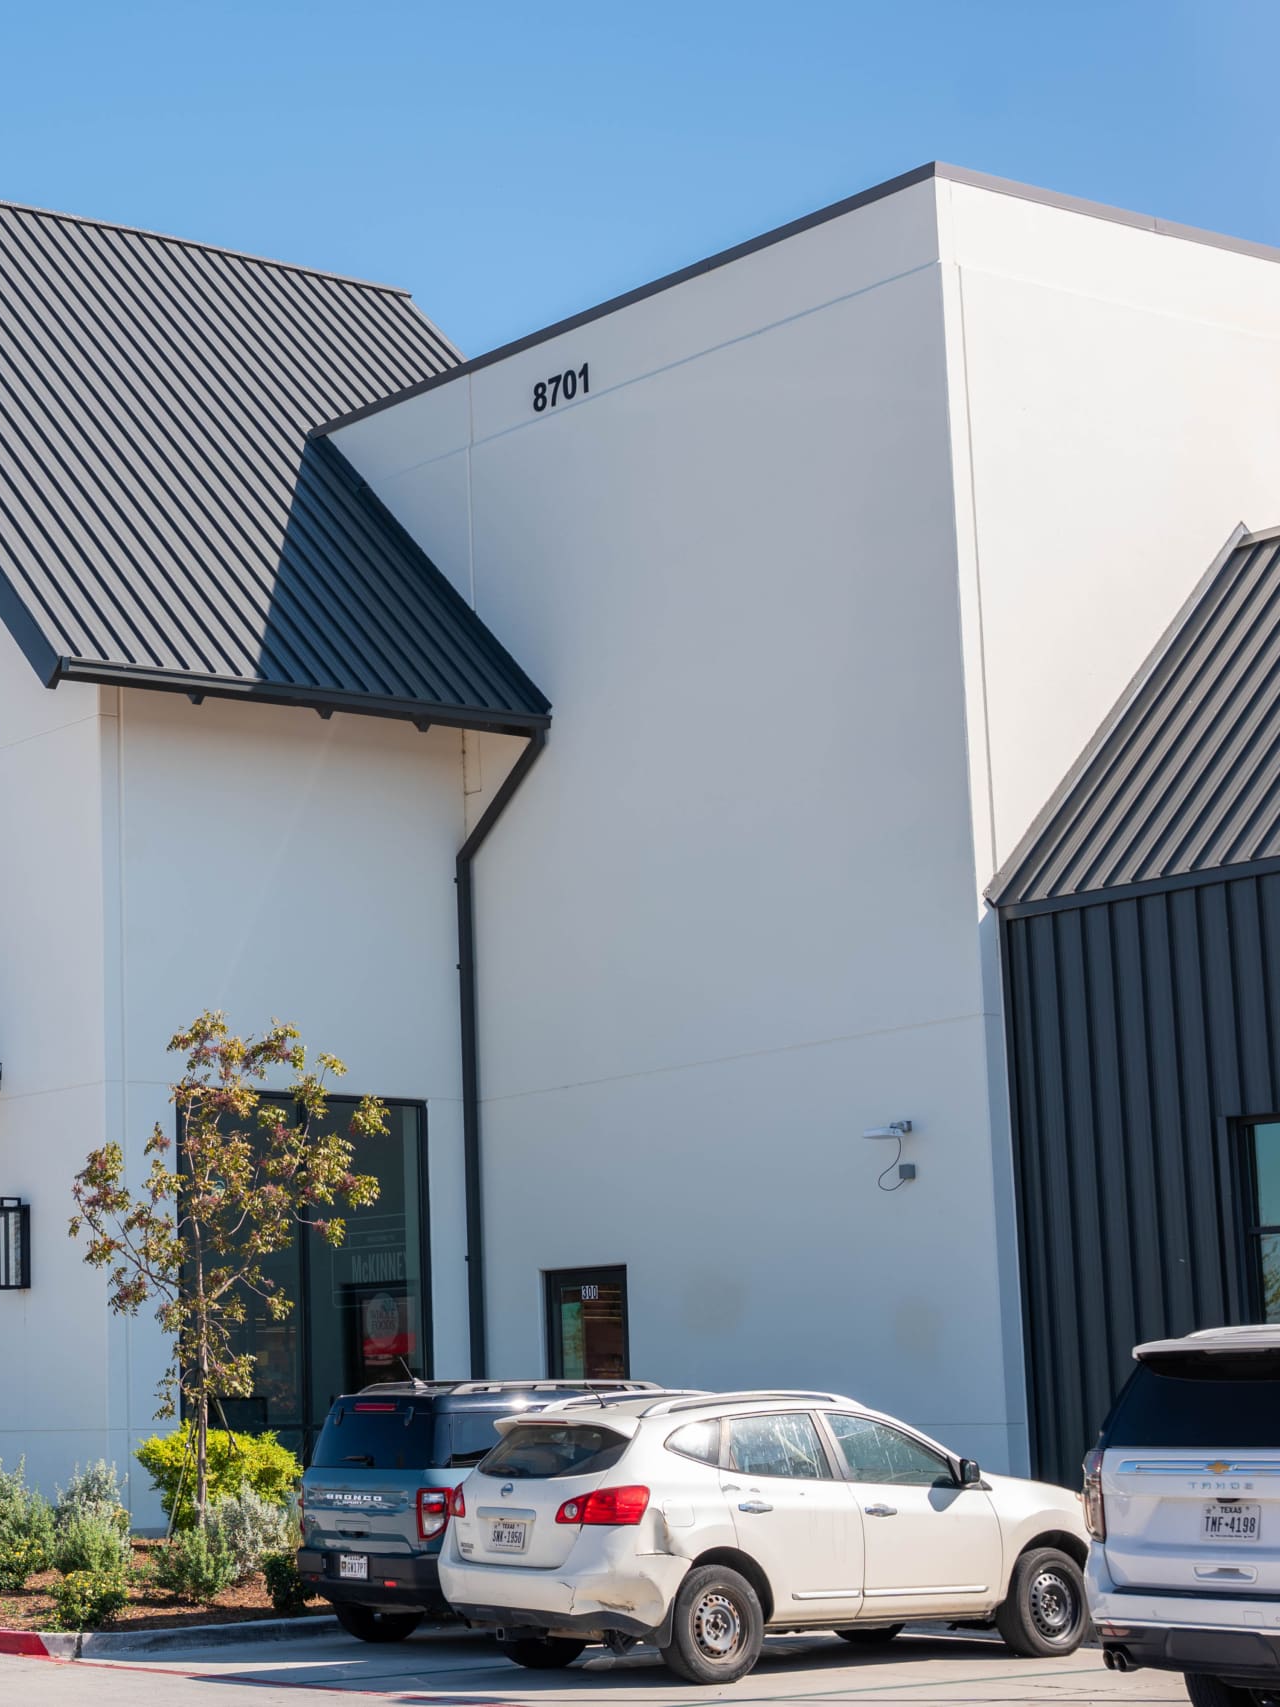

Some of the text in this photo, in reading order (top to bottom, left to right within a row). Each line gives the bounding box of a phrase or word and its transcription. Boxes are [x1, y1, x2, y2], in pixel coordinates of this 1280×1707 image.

[533, 362, 589, 412] 8701
[582, 1286, 597, 1299] 300
[1187, 1481, 1254, 1490] TAHOE
[326, 1493, 383, 1502] BRONCO
[1220, 1506, 1242, 1514] TEXAS
[502, 1522, 515, 1530] TEXAS
